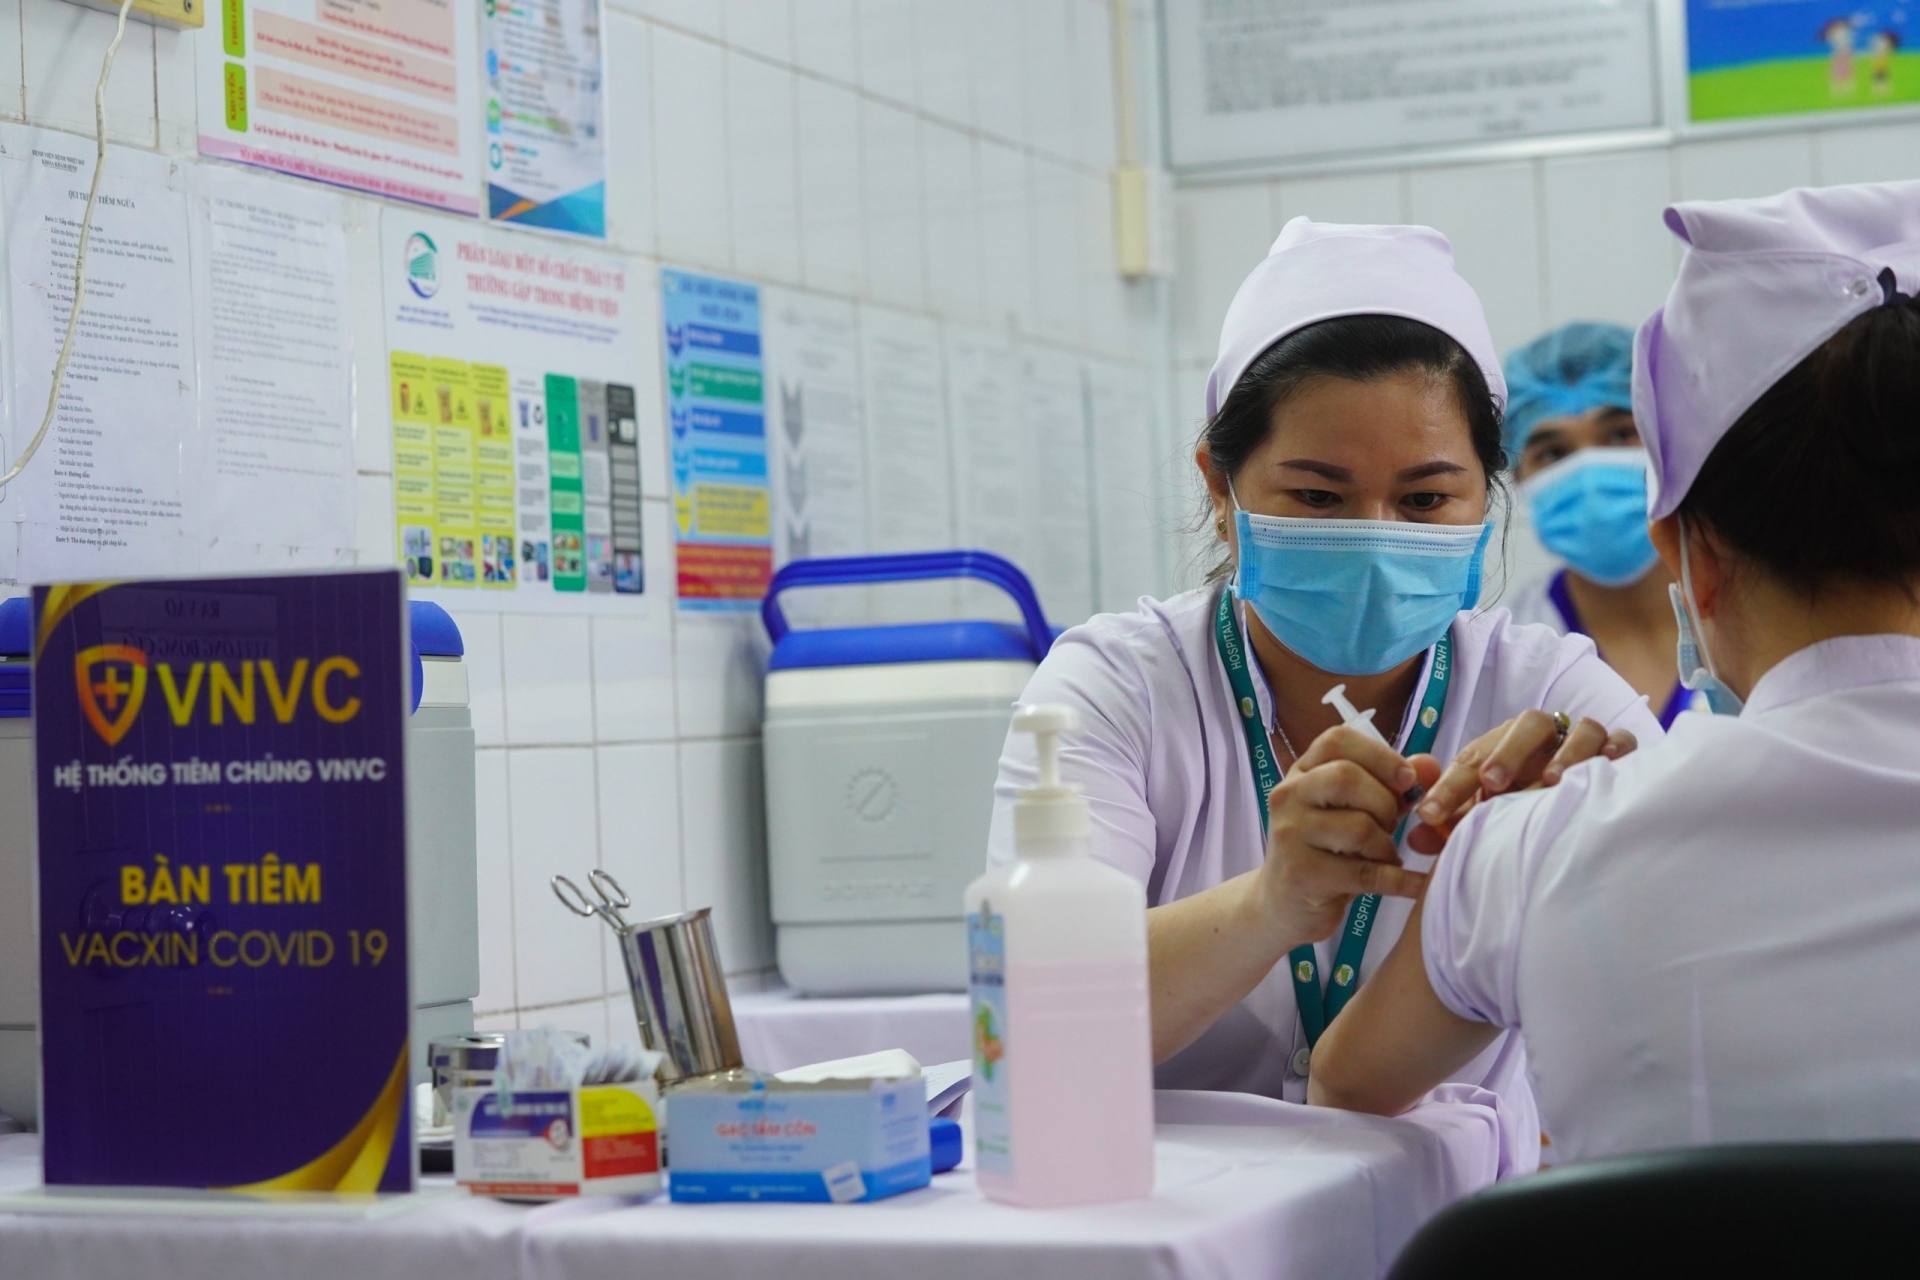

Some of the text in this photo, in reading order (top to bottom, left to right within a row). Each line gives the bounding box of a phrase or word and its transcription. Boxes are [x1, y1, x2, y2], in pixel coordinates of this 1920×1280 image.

[1220, 600, 1229, 621] FOR
[1222, 620, 1242, 671] HOSPITAL
[1434, 644, 1448, 681] BỆNH
[157, 656, 361, 727] VNVC
[54, 752, 387, 794] HỆ THỐNG TIÊM CHỦNG VNVC
[1260, 773, 1275, 812] IỆT
[120, 852, 322, 904] BÀN TIÊM
[1351, 892, 1374, 937] HOSPITA
[60, 929, 389, 967] VACXIN COVID 19
